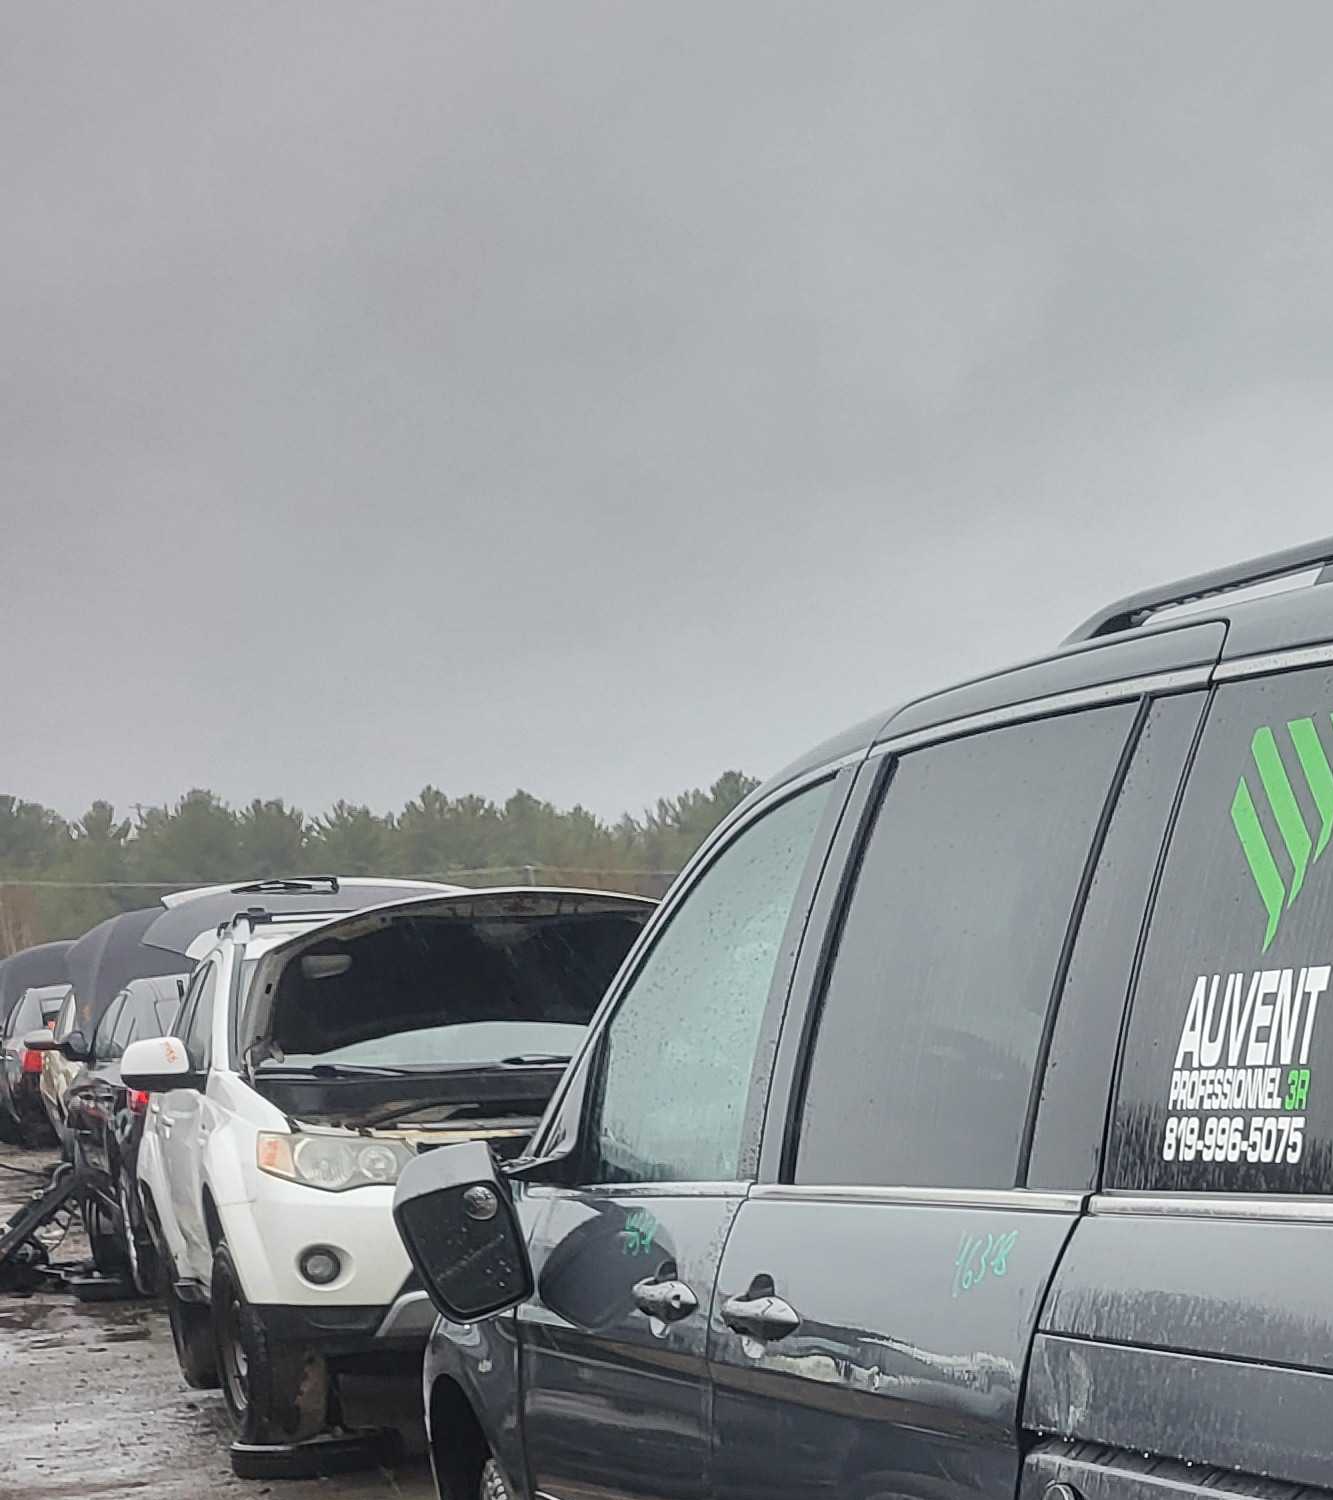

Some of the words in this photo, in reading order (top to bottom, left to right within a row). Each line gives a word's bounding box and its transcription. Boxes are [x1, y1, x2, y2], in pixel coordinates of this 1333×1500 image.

[1174, 965, 1332, 1068] AUVENT
[1168, 1068, 1283, 1111] PROFESSIONNEL
[1284, 1069, 1311, 1111] 3R
[1162, 1116, 1306, 1164] 819-996-5075
